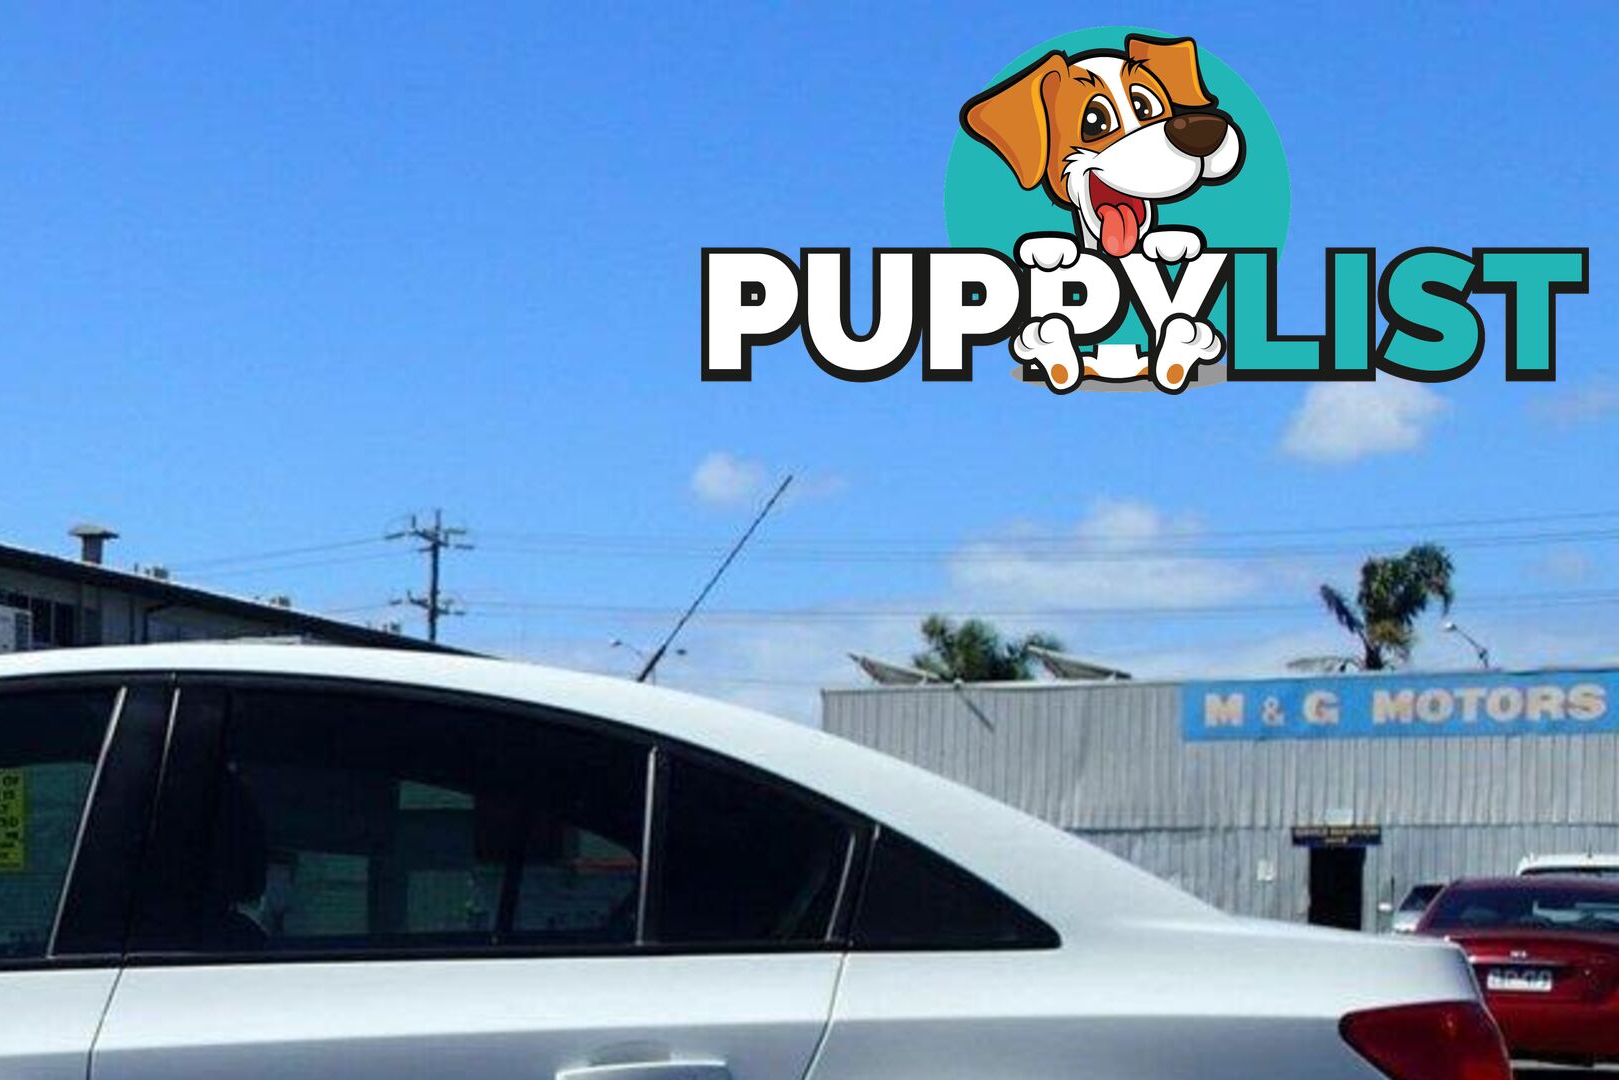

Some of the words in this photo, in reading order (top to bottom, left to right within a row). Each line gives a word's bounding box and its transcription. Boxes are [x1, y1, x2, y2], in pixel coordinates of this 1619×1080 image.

[1204, 693, 1245, 727] M
[1262, 696, 1286, 727] &
[1304, 691, 1340, 725] G
[1372, 683, 1607, 724] MOTORS
